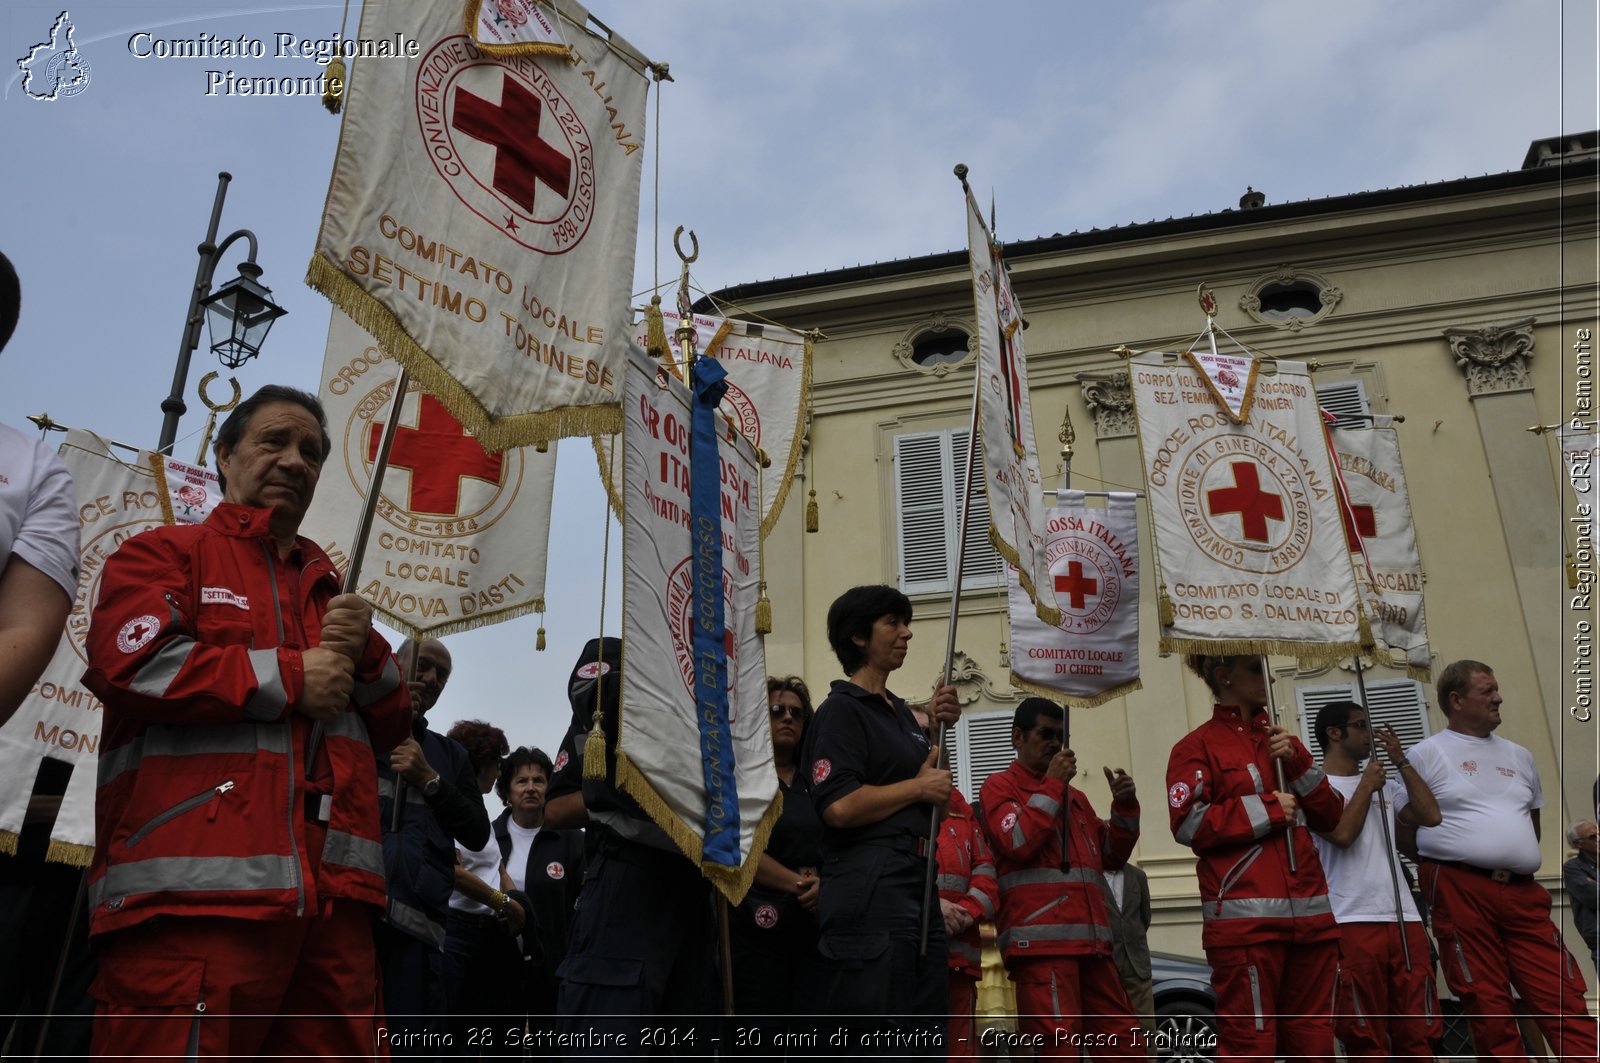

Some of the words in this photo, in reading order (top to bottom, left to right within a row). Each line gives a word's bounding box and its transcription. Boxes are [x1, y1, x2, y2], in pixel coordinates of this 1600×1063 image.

[421, 42, 467, 177] CONVENZIONE
[560, 112, 582, 137] 22
[572, 140, 593, 223] AGOSTO
[553, 219, 579, 247] 1864
[379, 214, 514, 295] COMITATO
[523, 285, 605, 346] LOCALE
[347, 245, 488, 323] SETTIMO
[500, 310, 616, 396] TORINESE
[719, 346, 793, 370] ITALIANA
[1138, 372, 1173, 388] CORPO
[1260, 382, 1307, 398] SOCCORSO
[1154, 390, 1179, 405] SEZ.
[737, 401, 757, 442] AGOST
[1150, 427, 1190, 488] CROCE
[1259, 419, 1329, 501] ITALIANA
[1197, 451, 1212, 466] DI
[1215, 438, 1277, 469] GINEVRA
[1279, 468, 1298, 488] 22
[1181, 468, 1244, 565] CONVENZIONE
[1291, 490, 1308, 546] AGOSTO
[378, 532, 480, 565] COMITATO
[1088, 521, 1136, 579] ITALIANA
[1270, 547, 1301, 567] 1864
[385, 560, 470, 588] LOCALE
[699, 515, 716, 633] SOCCORSO
[1056, 540, 1100, 563] GINEVRA
[1101, 575, 1117, 617] AGOSTO
[1376, 573, 1421, 592] OCALE
[1174, 582, 1260, 600] COMITATO
[1265, 584, 1320, 603] LOCALE
[1325, 591, 1342, 605] DI
[1240, 603, 1259, 620] S.
[1264, 604, 1357, 625] DALMAZZO
[701, 647, 717, 689] DEL
[1029, 648, 1086, 660] COMITATO
[1088, 650, 1124, 662] LOCALE
[1055, 663, 1067, 674] DI
[1069, 664, 1103, 676] CHIERI
[704, 700, 726, 835] VOLONTARI
